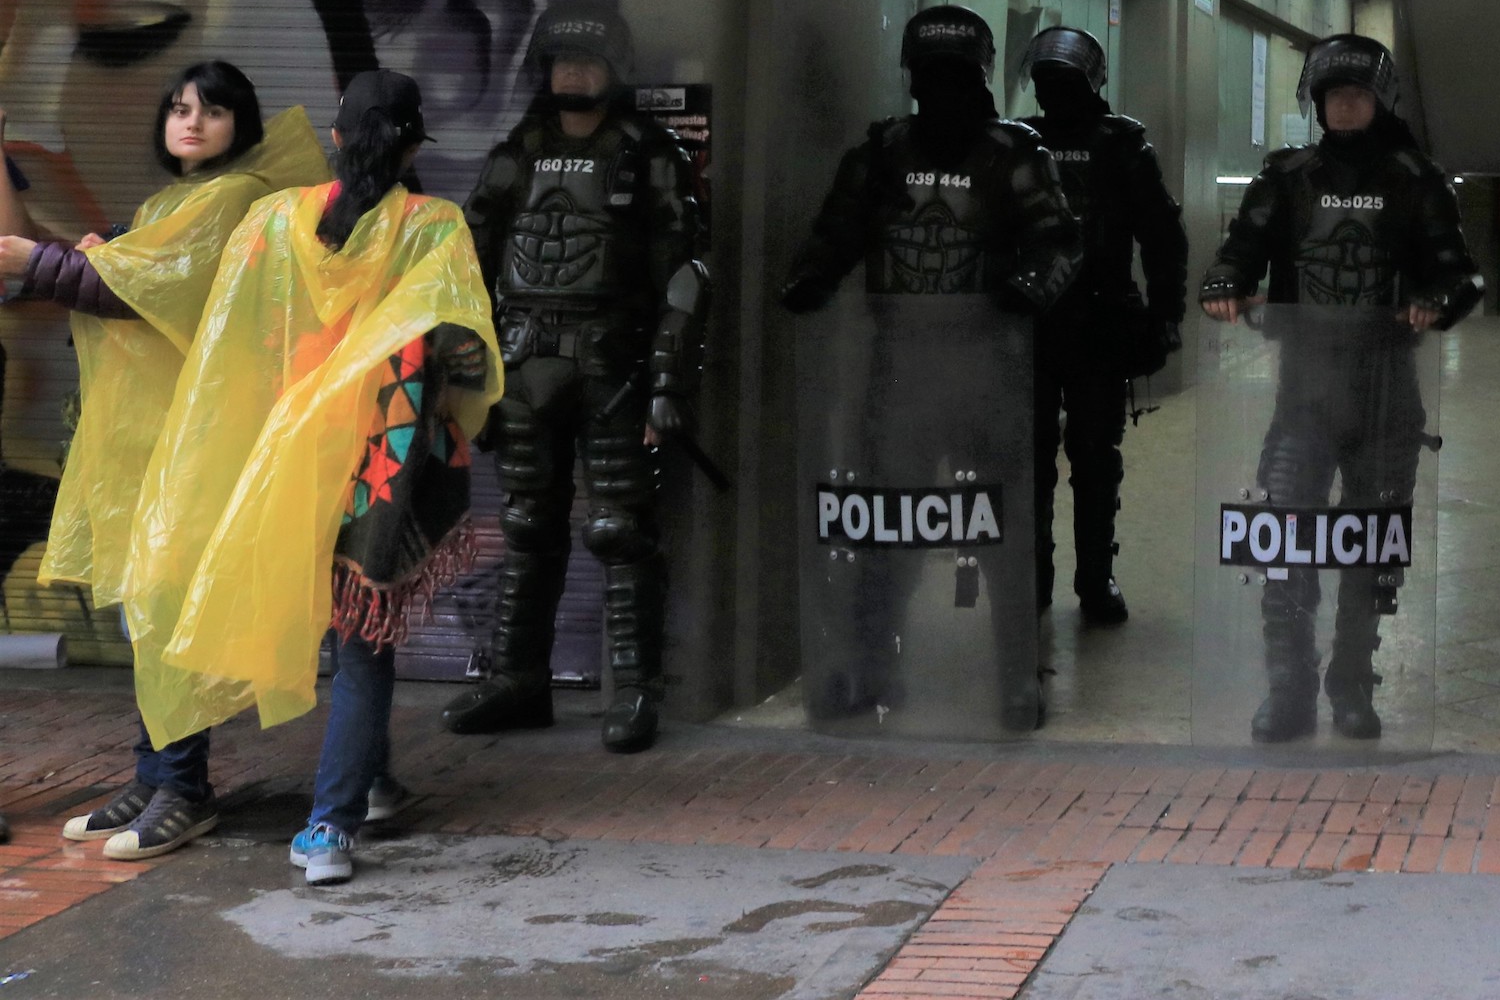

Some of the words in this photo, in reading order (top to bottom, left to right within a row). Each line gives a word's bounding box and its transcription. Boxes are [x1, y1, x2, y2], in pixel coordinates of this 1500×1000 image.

[533, 158, 595, 174] 160372
[817, 491, 1001, 543] POLICIA
[1221, 509, 1410, 565] POLICIA
